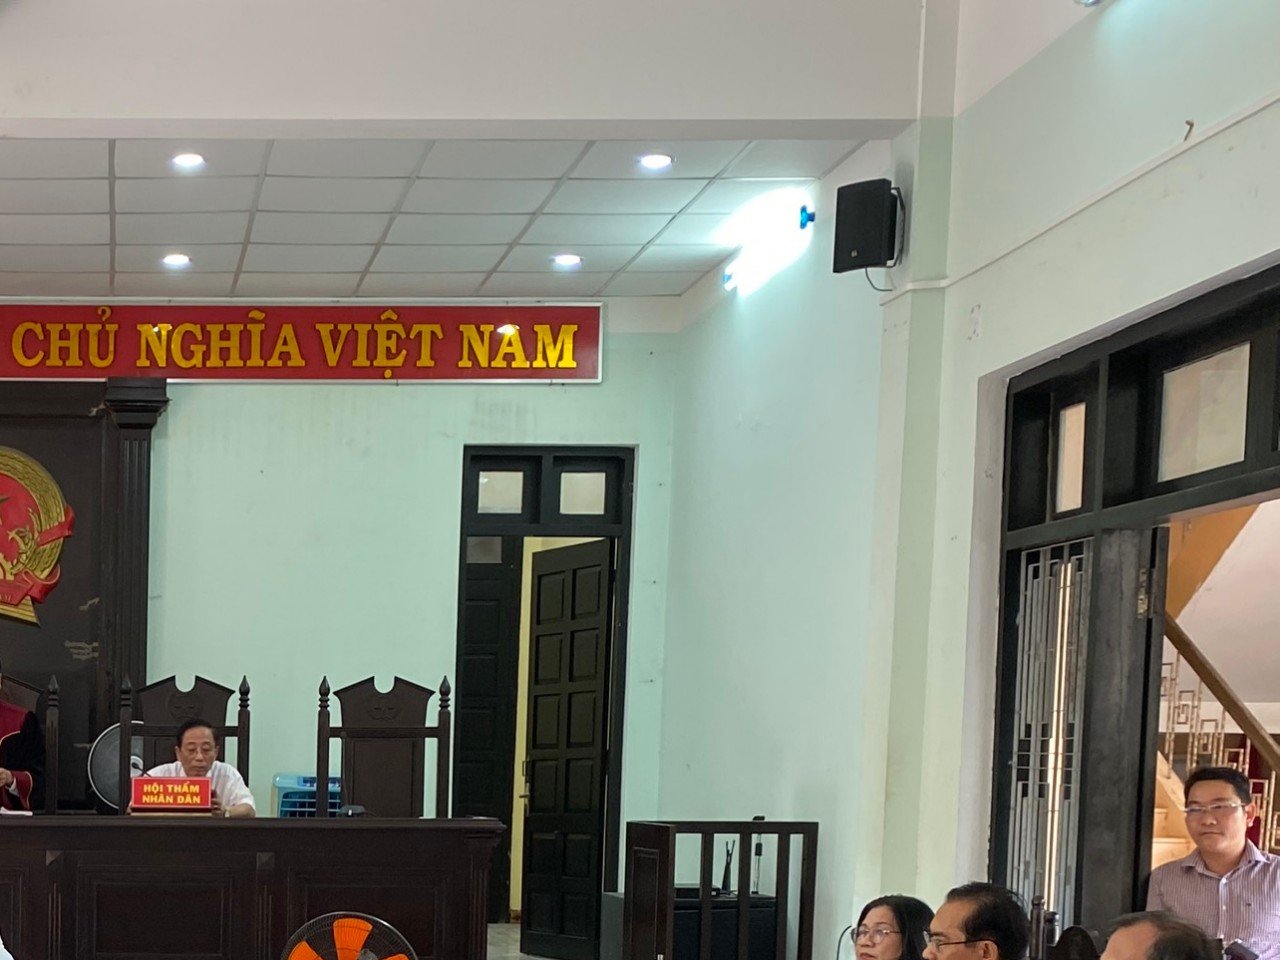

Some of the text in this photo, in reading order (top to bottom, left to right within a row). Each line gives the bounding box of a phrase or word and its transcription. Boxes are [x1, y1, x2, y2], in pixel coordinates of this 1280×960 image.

[12, 306, 118, 368] CHỦ
[136, 310, 306, 369] NGHĨA
[316, 310, 443, 379] VIỆT
[457, 323, 578, 369] NAM
[143, 781, 200, 794] HỘI THẨM
[142, 793, 201, 804] NHÂN DÂN
